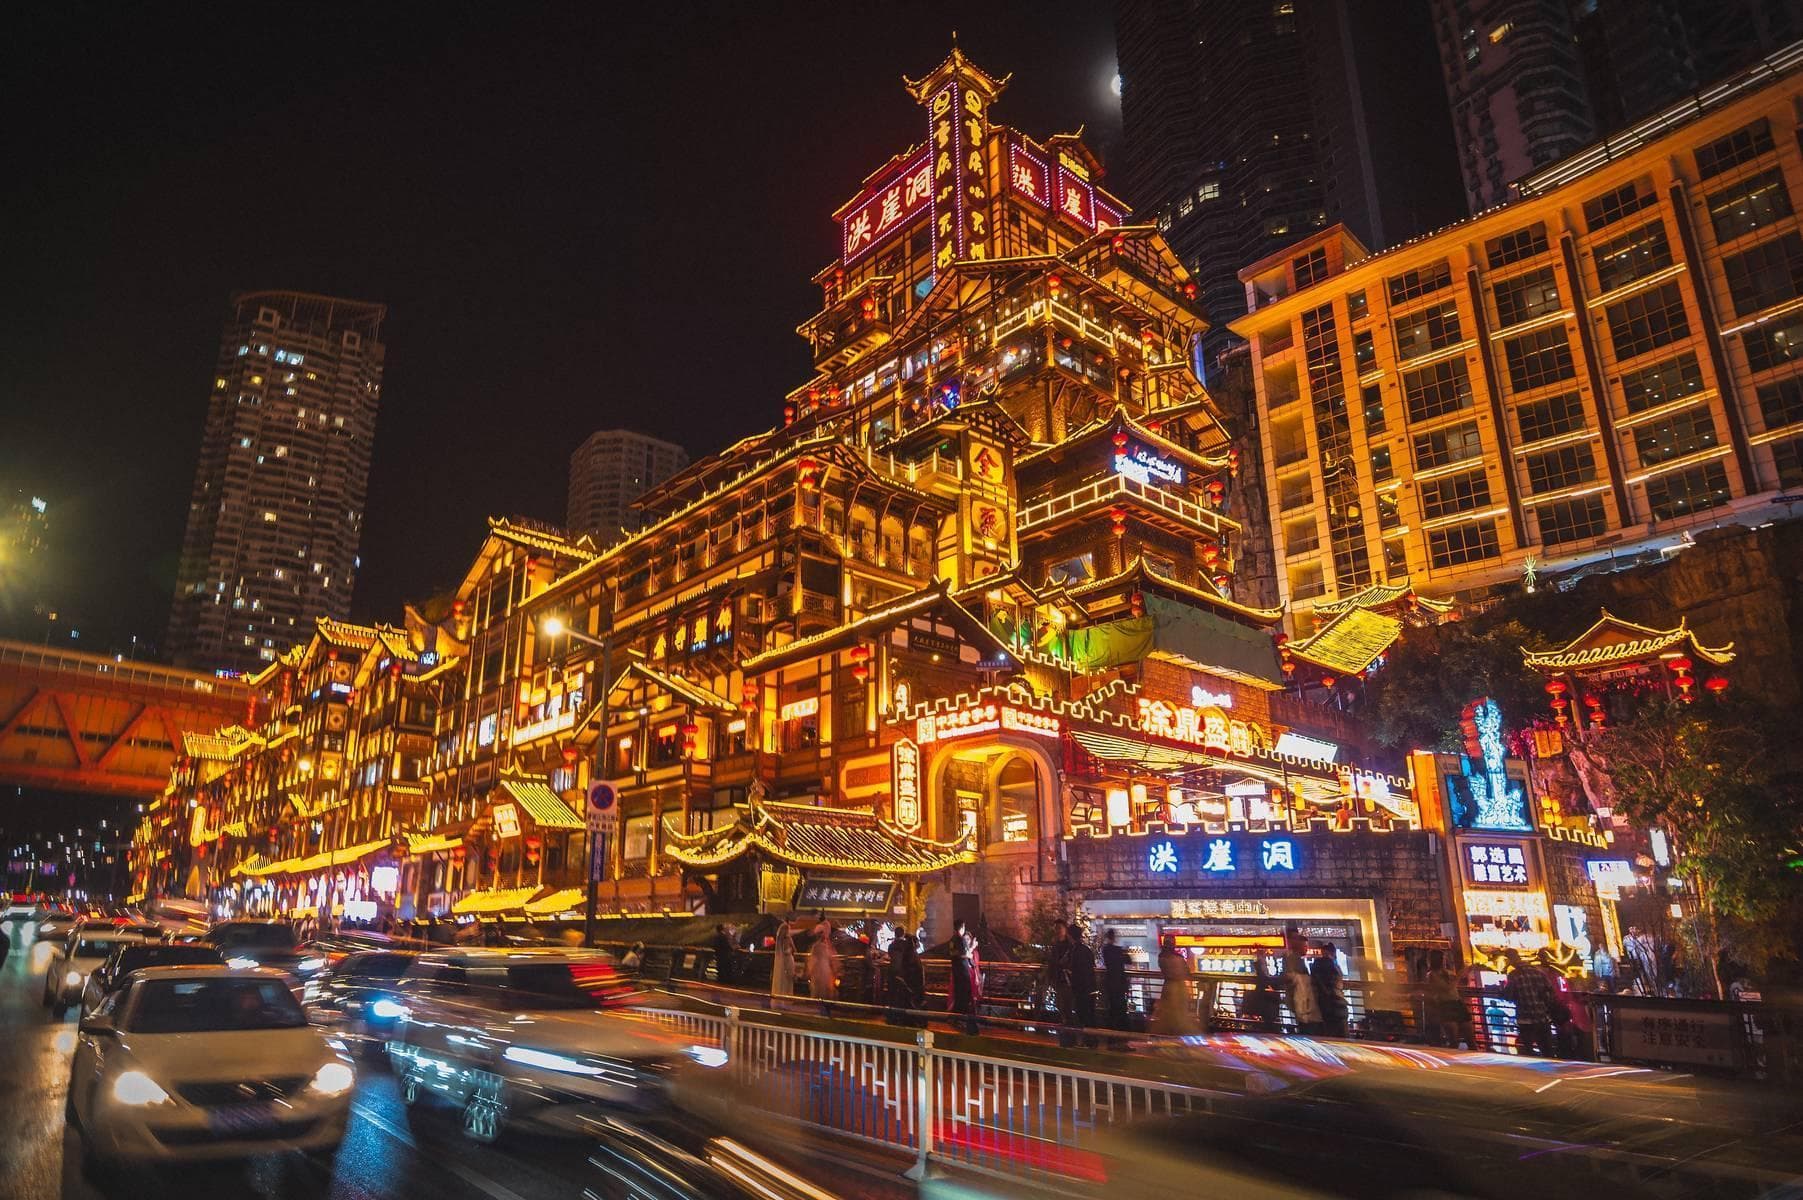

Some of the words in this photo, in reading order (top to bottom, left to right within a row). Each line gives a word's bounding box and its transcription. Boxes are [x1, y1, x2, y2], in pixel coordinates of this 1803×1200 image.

[848, 165, 931, 253] 洪崖洞
[1149, 840, 1294, 873] 洪崖洞
